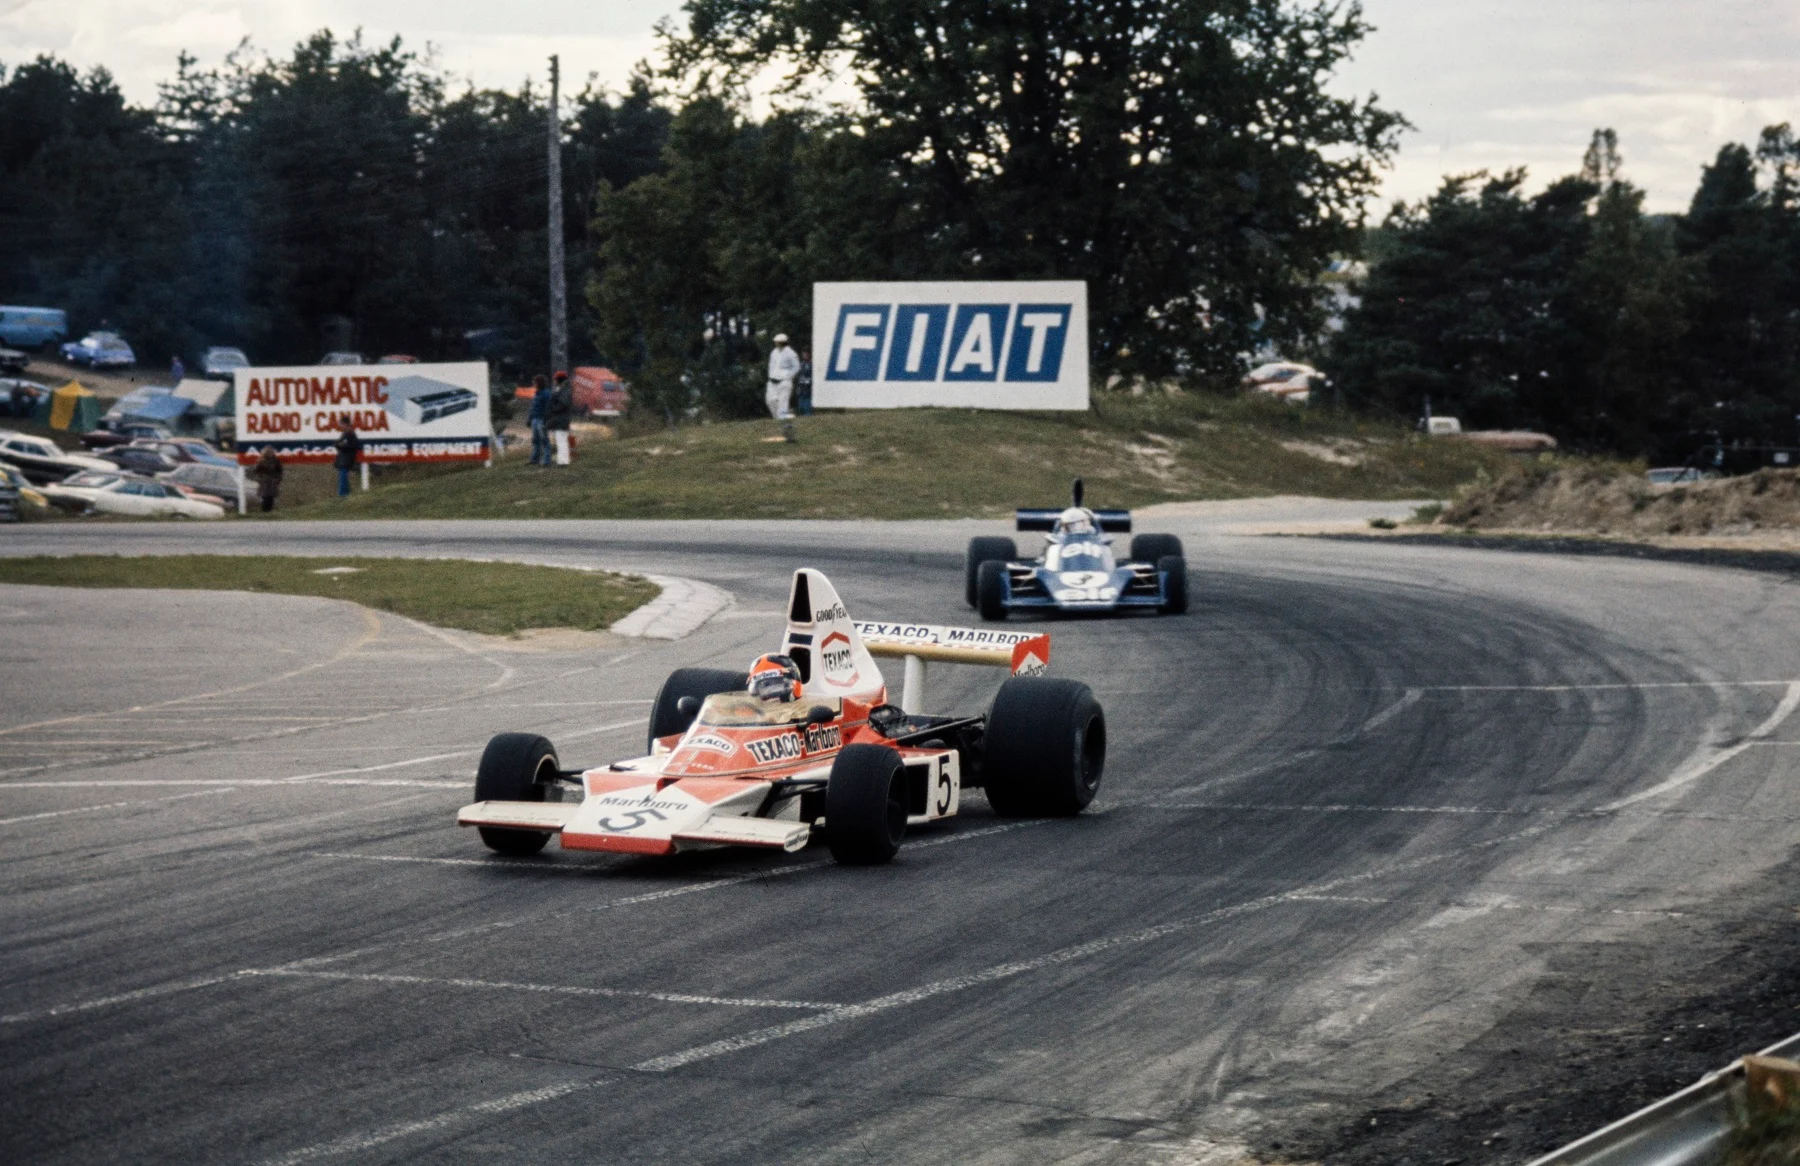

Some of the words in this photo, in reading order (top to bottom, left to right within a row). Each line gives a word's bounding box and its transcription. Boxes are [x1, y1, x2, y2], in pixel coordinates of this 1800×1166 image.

[834, 312, 1063, 374] FIAT
[246, 377, 388, 406] AUTOMATIC
[246, 411, 300, 433] RADIO
[363, 443, 407, 456] RACING
[412, 442, 481, 457] EQUIPMENT
[746, 733, 801, 763] TEXACO
[804, 722, 842, 752] Marlboro
[937, 754, 951, 816] 5
[600, 795, 688, 810] Marlboro
[598, 808, 667, 832] 5
